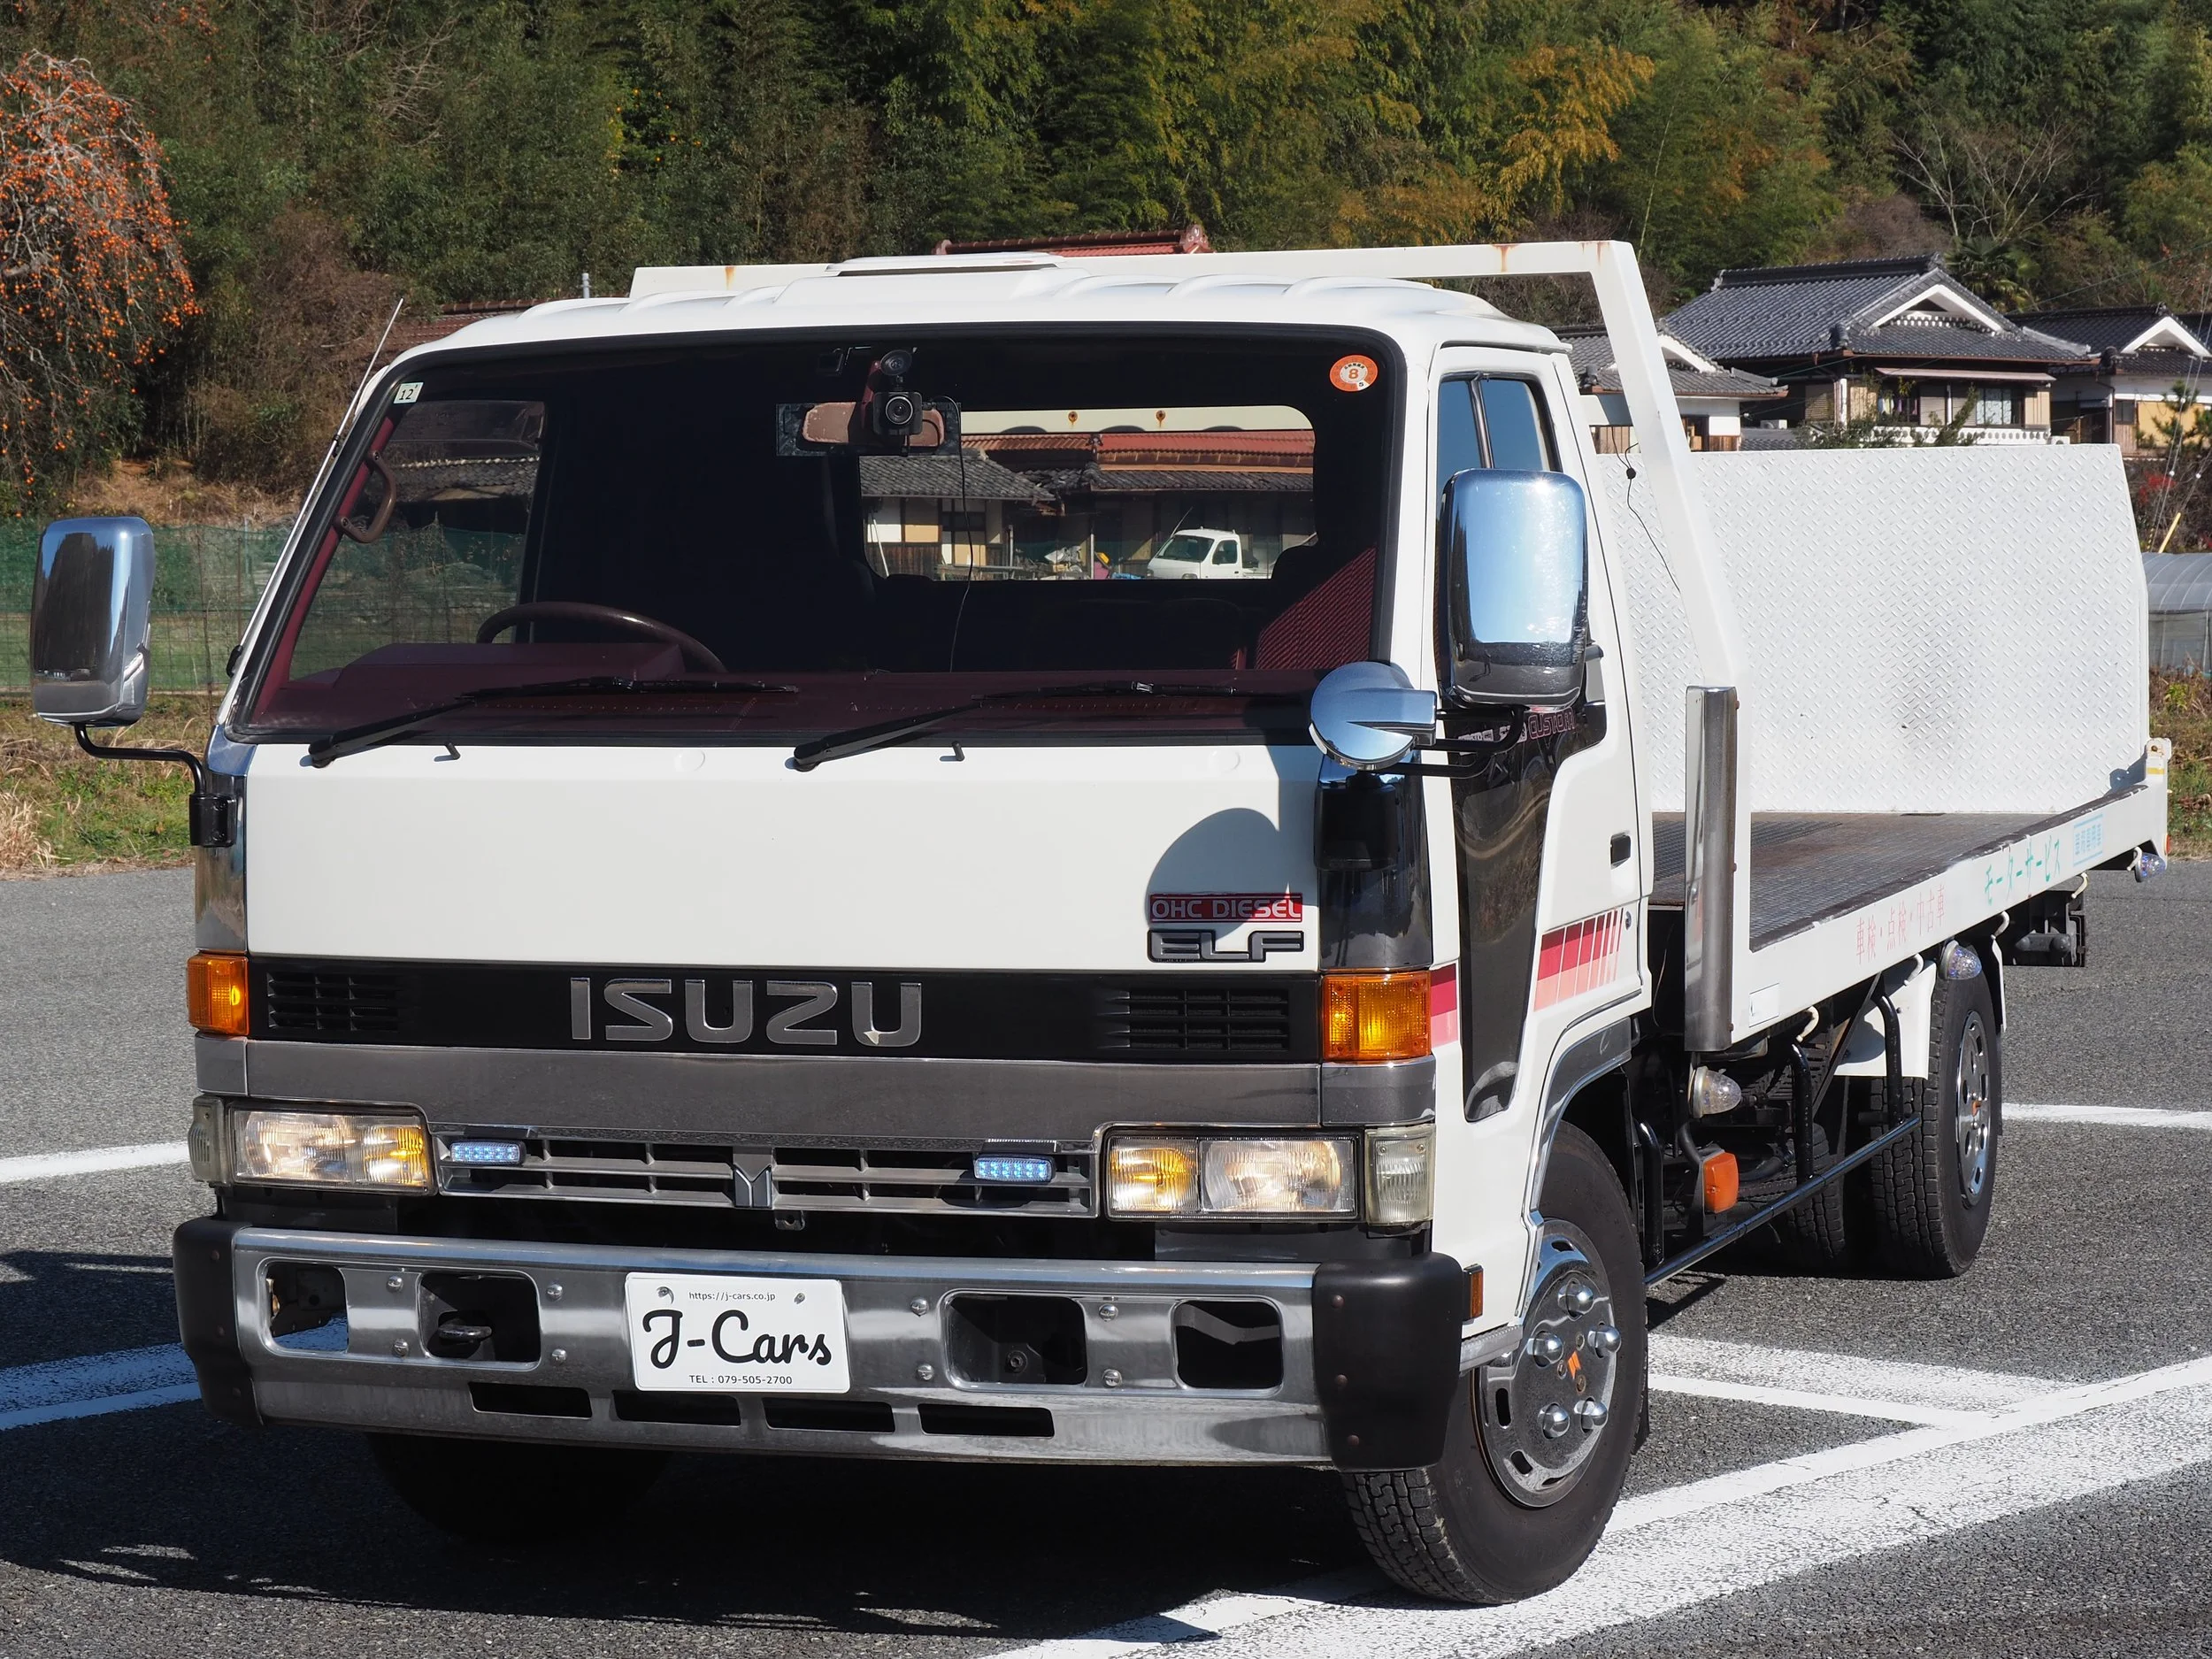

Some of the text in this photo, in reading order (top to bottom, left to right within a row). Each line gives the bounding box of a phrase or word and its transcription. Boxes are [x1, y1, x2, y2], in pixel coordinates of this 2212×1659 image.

[1348, 368, 1359, 379] 8
[398, 388, 414, 401] 12
[1151, 899, 1302, 918] OHC DIESEL
[1148, 930, 1303, 962] ELF
[570, 977, 922, 1047] ISUZU
[688, 1291, 776, 1302] https://j-cars.co.jp
[642, 1309, 832, 1369] J-Cars
[718, 1375, 793, 1385] 079-505-2700
